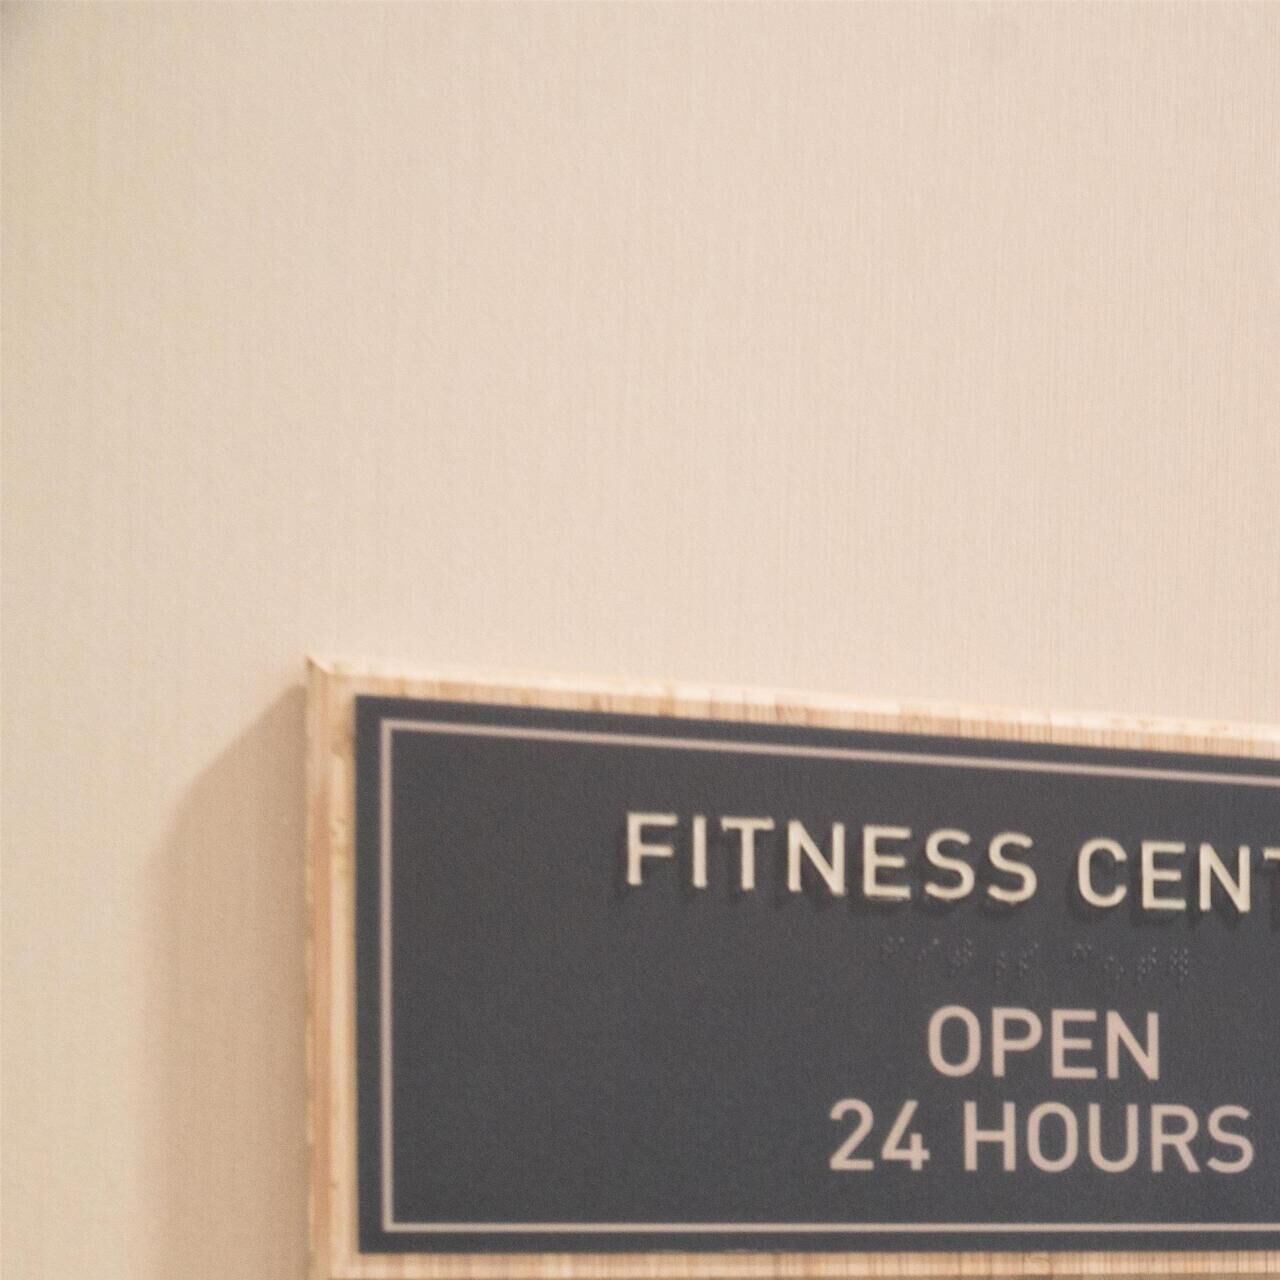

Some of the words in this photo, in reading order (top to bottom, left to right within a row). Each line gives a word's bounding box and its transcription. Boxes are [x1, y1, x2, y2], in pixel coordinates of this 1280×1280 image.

[626, 810, 1040, 905] FITNESS
[926, 1004, 1161, 1081] OPEN
[829, 1098, 931, 1171] 24
[962, 1100, 1255, 1174] HOURS
